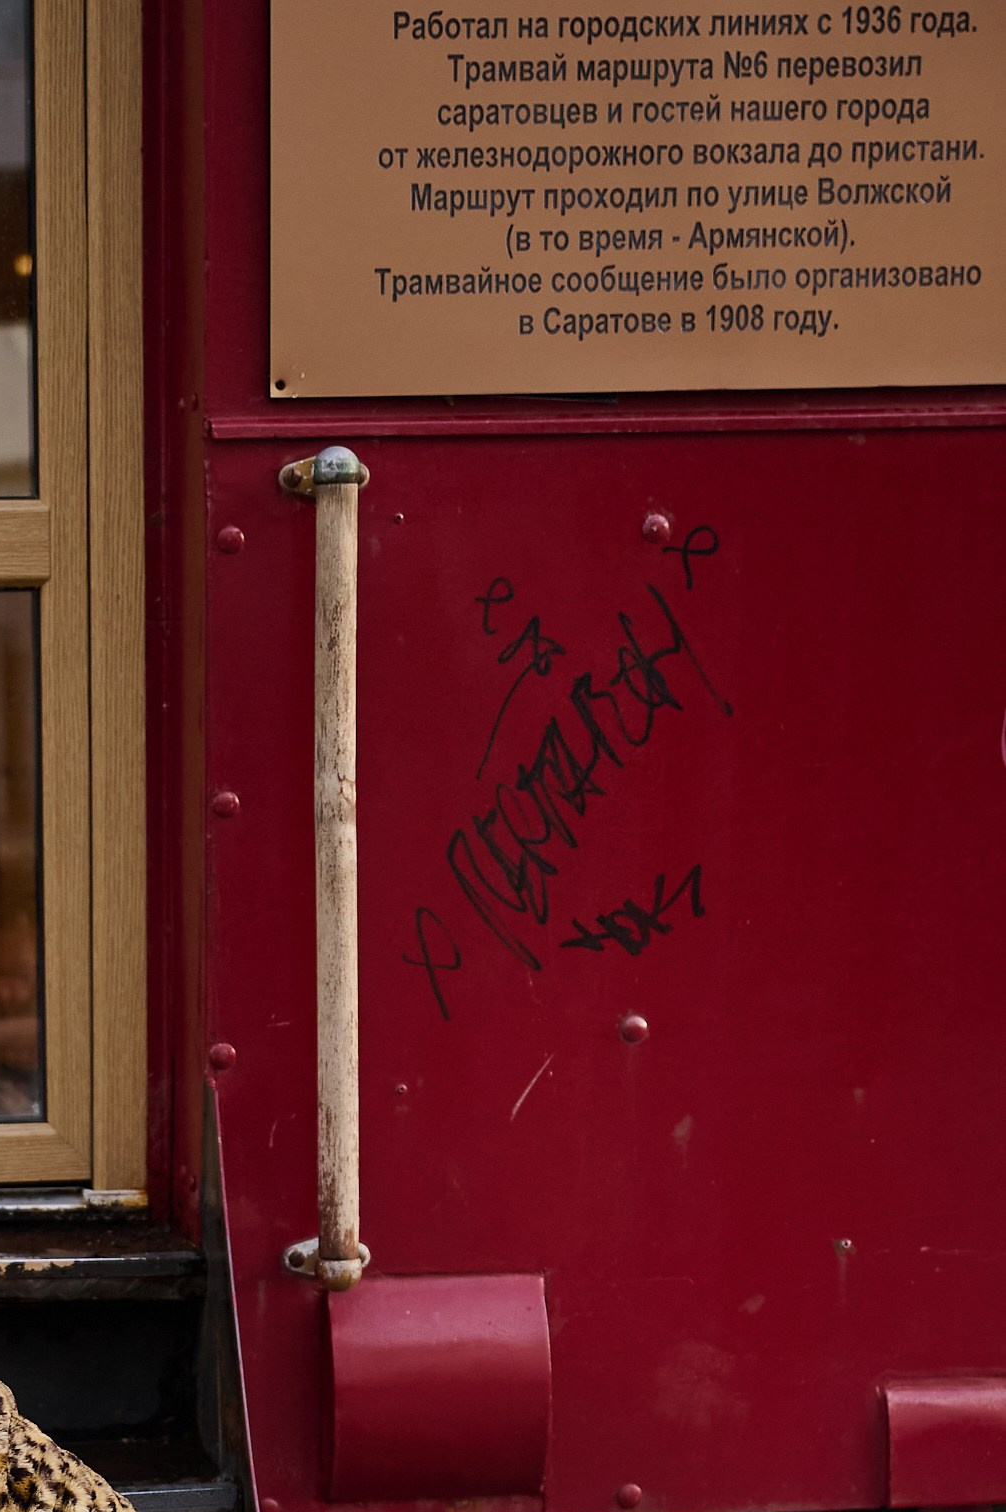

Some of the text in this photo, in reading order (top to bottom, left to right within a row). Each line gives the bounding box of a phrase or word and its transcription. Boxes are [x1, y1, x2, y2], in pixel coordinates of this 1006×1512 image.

[393, 4, 978, 45] Работал на городских линиях с 1936 года.
[446, 50, 923, 88] Трамвай маршрута №6 перевозил
[437, 93, 930, 131] саратовцев и гостей нашего города
[378, 139, 985, 175] от железнодорожного вокзала до пристани.
[411, 174, 952, 219] Маршрут проходил по улице Волжской
[506, 223, 531, 260] (в
[538, 230, 570, 252] то
[578, 228, 663, 258] время
[687, 218, 855, 257] Армянской).
[373, 262, 982, 303] Трамвайное сообщение было организовано
[519, 303, 839, 342] в Саратове в 1908 году.
